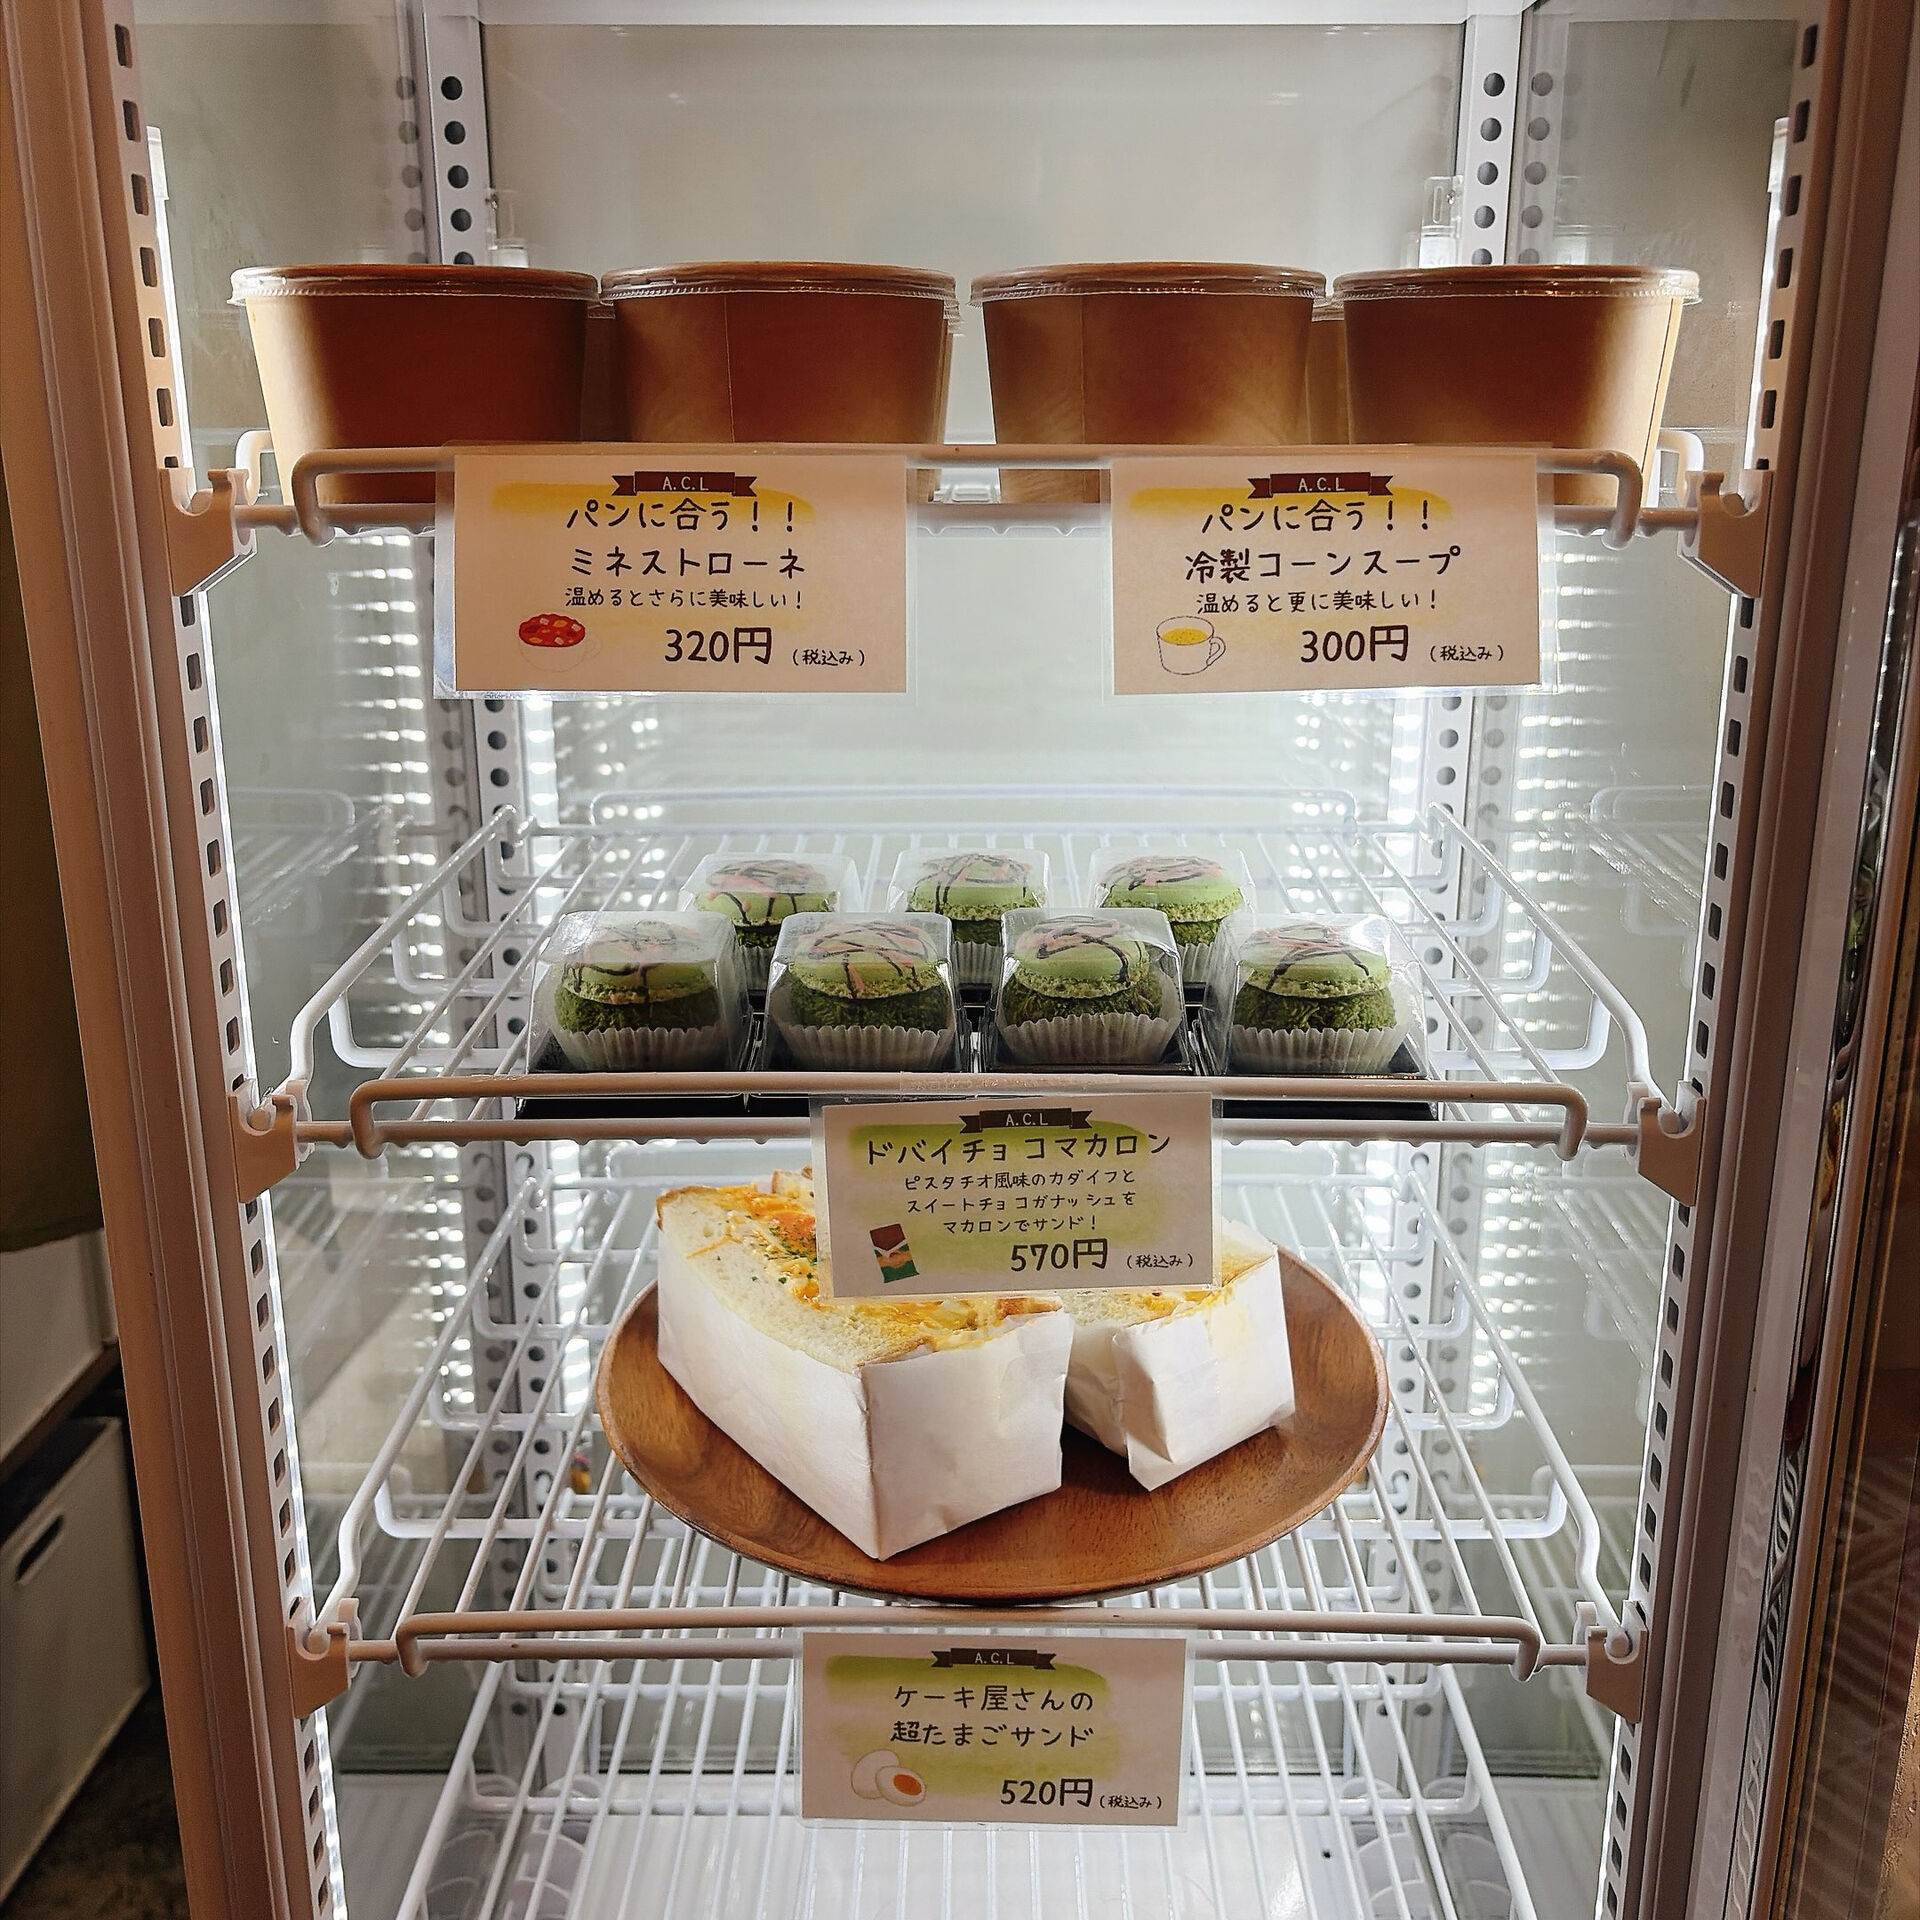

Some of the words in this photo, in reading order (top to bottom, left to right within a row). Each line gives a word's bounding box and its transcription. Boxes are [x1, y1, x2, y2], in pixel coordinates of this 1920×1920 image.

[663, 476, 709, 491] A.C.L
[1298, 477, 1345, 492] A.C.L
[571, 546, 804, 579] ミネストローネ
[1185, 545, 1461, 583] 冷製コーンスープ
[664, 627, 771, 664] 320円
[1300, 624, 1408, 662] 300円
[1005, 1113, 1048, 1127] A.C.L
[905, 1168, 1136, 1191] ピスタチオ風味のカダイフと
[1010, 1238, 1107, 1272] 570円
[974, 1652, 1015, 1665] A.C.L
[893, 1684, 1093, 1712] ケーキ屋さんの
[890, 1721, 1094, 1748] 超たまごサンド
[1000, 1778, 1093, 1808] 520円
